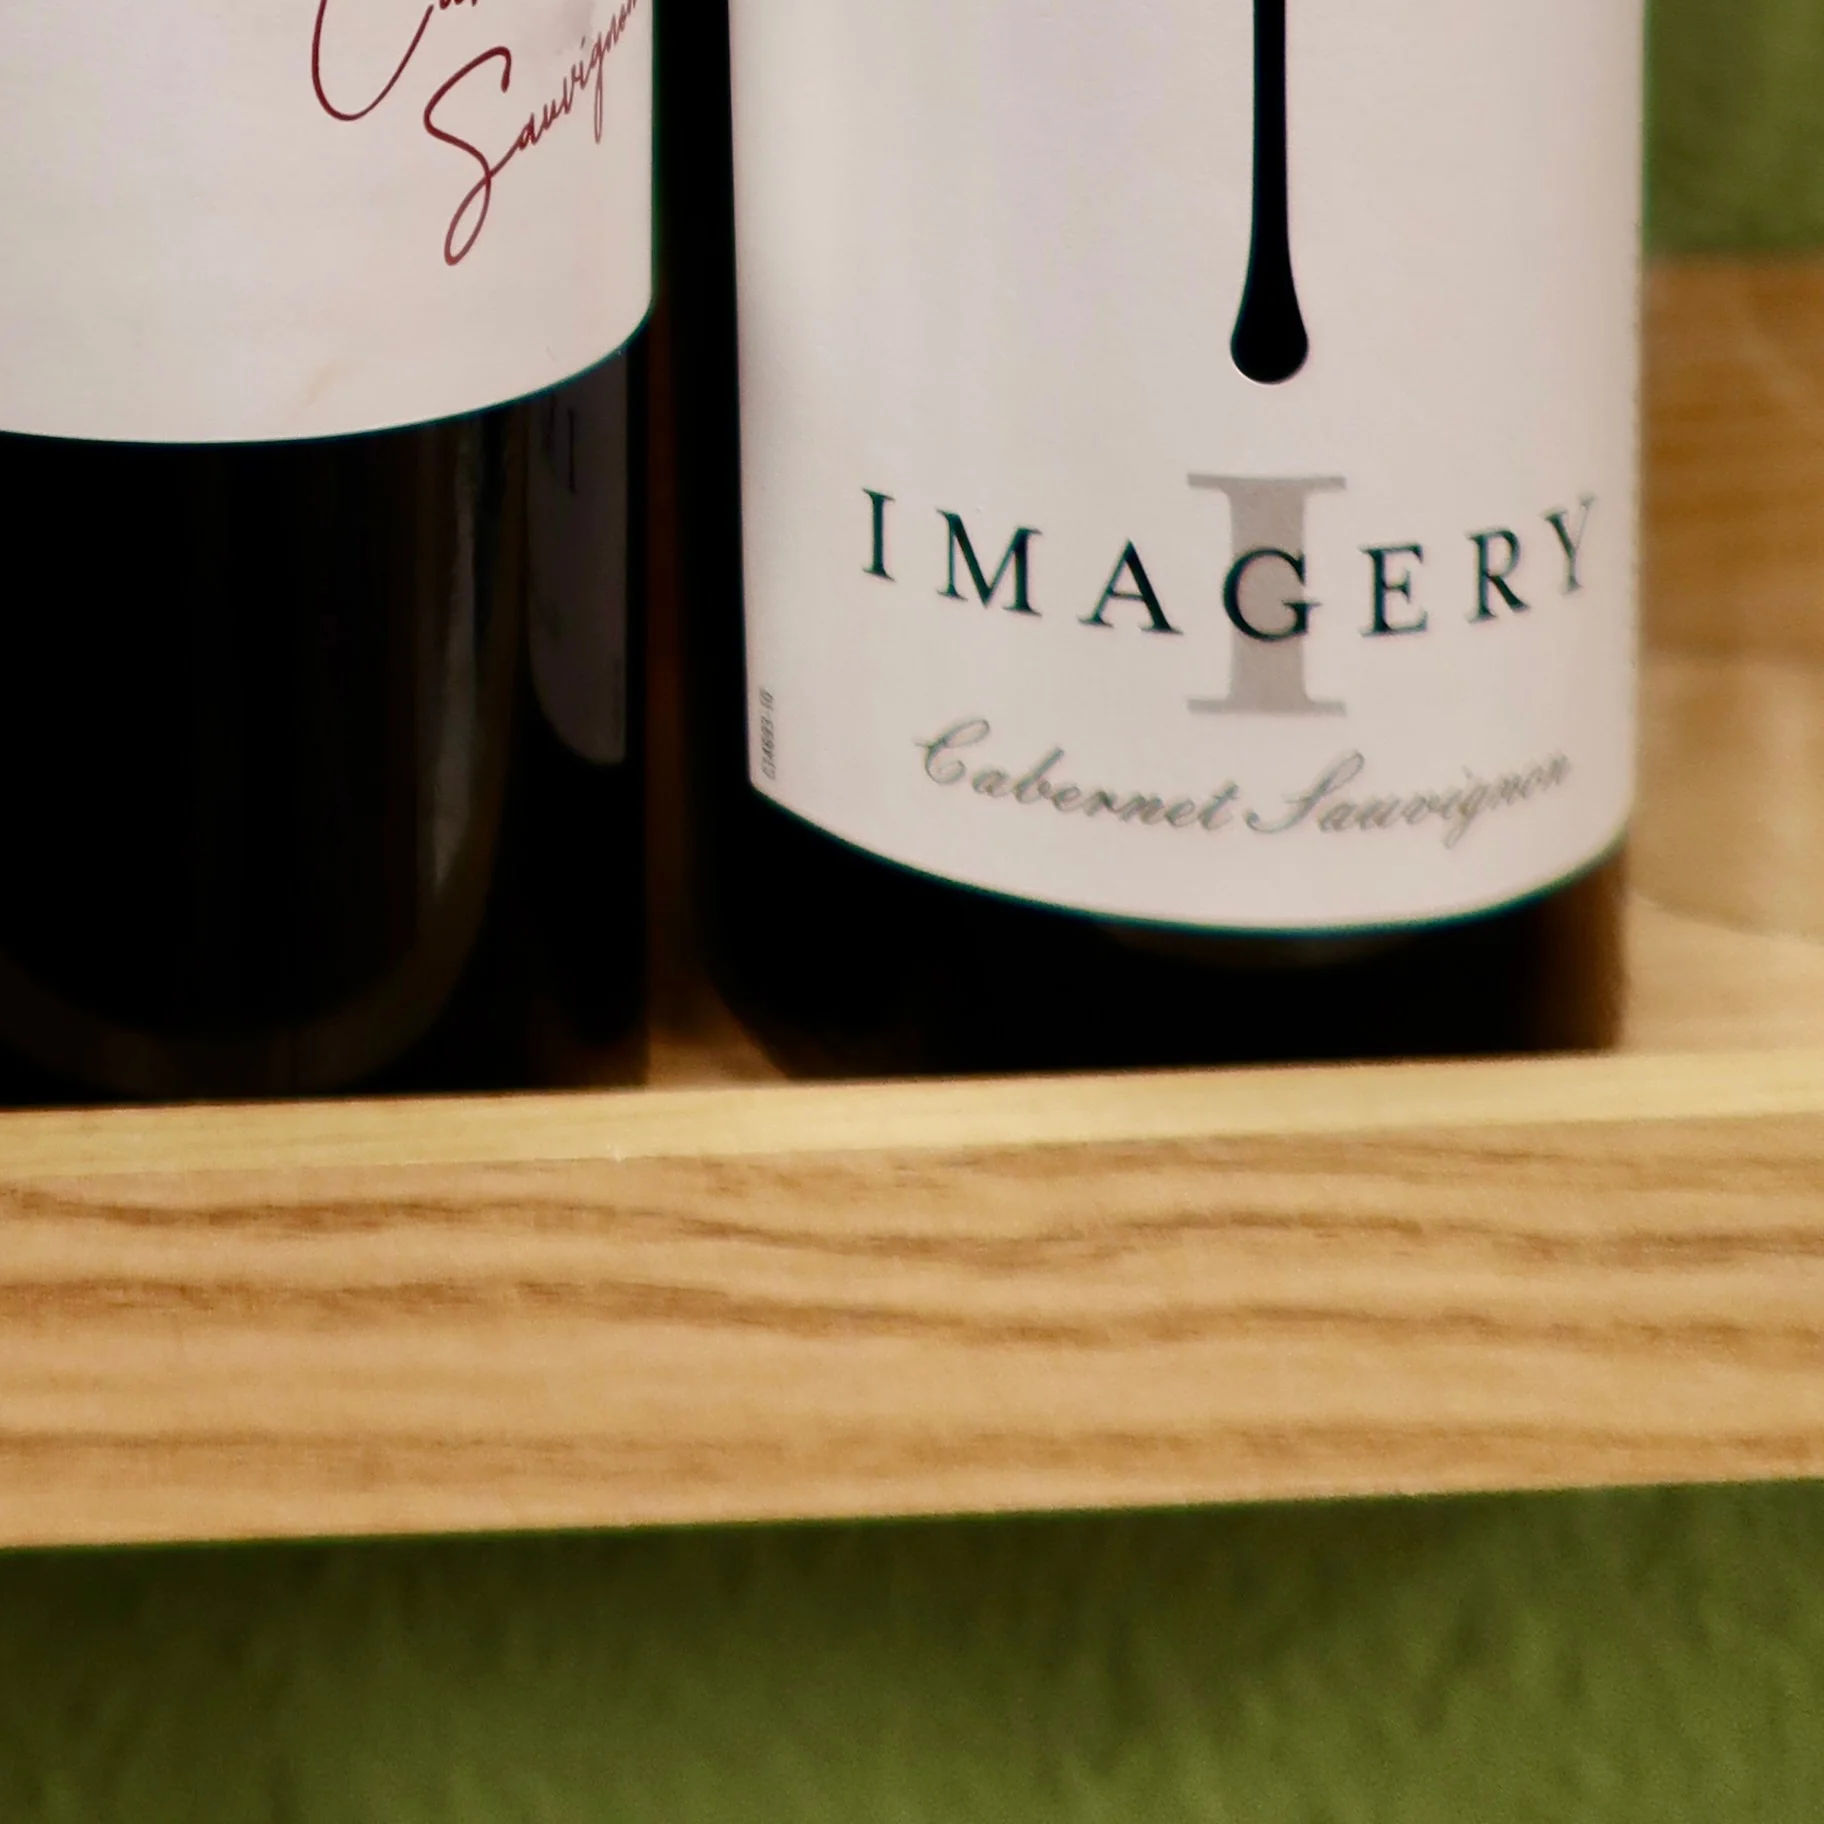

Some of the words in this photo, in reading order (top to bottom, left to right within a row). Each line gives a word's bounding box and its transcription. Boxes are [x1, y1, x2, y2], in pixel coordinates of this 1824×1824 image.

[860, 488, 1596, 645] IMAGERY
[914, 718, 1240, 834] Cabernet
[1244, 748, 1574, 849] Sauvignon
